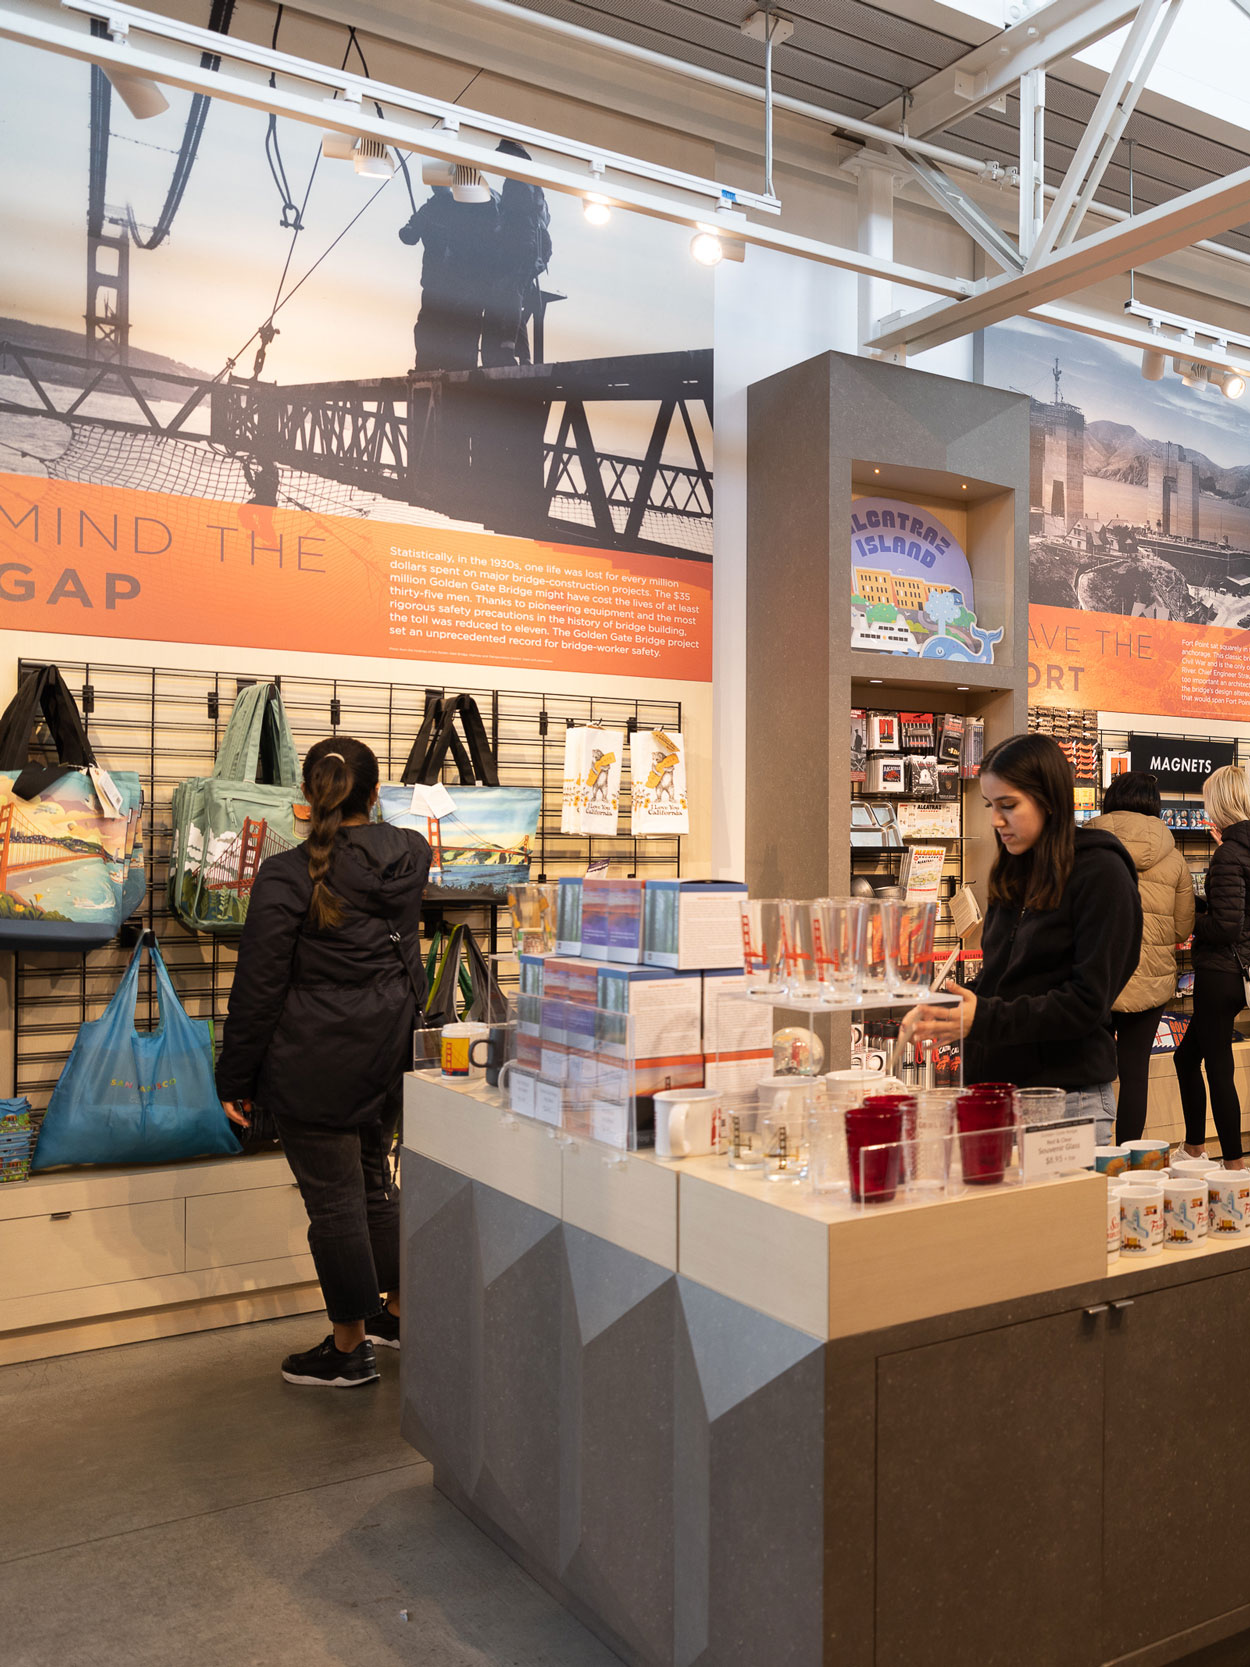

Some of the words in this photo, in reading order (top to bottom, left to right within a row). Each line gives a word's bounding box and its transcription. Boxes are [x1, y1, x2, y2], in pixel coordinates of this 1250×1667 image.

[0, 504, 172, 555] MIND
[206, 525, 326, 573] THE
[851, 510, 951, 556] LCATRAZ
[855, 534, 937, 569] ISLAND
[390, 546, 454, 564] Statistically,
[457, 554, 467, 563] in
[470, 555, 487, 566] the
[490, 558, 521, 571] 1930s,
[524, 564, 543, 572] one
[546, 564, 561, 574] life
[563, 568, 582, 577] was
[585, 568, 602, 579] lost
[605, 571, 618, 581] for
[621, 575, 646, 586] every
[649, 576, 679, 588] million
[390, 559, 426, 571] dollars
[429, 565, 459, 575] spent
[463, 569, 476, 577] on
[479, 570, 508, 582] major
[512, 572, 609, 591] bridge-construction
[611, 584, 650, 596] projects.
[655, 588, 670, 598] The
[673, 590, 691, 600] $35
[0, 562, 141, 610] GAP
[390, 573, 426, 584] million
[429, 576, 468, 589] Golden
[470, 581, 495, 592] Gate
[498, 584, 532, 597] Bridge
[535, 588, 564, 600] might
[566, 591, 589, 602] have
[592, 595, 612, 604] cost
[614, 596, 630, 606] the
[632, 597, 652, 608] lives
[655, 600, 664, 610] of
[667, 602, 675, 611] at
[678, 602, 699, 613] least
[390, 585, 443, 599] thirty-five
[446, 593, 472, 602] men.
[476, 594, 511, 606] Thanks
[514, 598, 525, 607] to
[528, 600, 581, 615] pioneering
[583, 606, 634, 618] equipment
[636, 611, 654, 620] and
[656, 612, 671, 622] the
[673, 615, 696, 625] most
[390, 599, 435, 611] rigorous
[438, 604, 470, 617] safety
[473, 608, 534, 620] precautions
[536, 612, 545, 621] in
[548, 613, 564, 623] the
[567, 615, 600, 628] history
[602, 618, 613, 627] of
[615, 619, 645, 632] bridge
[648, 622, 687, 636] building,
[389, 612, 407, 622] the
[410, 614, 428, 624] toll
[431, 618, 452, 626] was
[455, 619, 498, 630] reduced
[501, 622, 511, 631] to
[514, 623, 548, 635] eleven.
[553, 626, 570, 636] The
[573, 628, 607, 640] Golden
[610, 631, 632, 642] Gate
[634, 633, 665, 646] Bridge
[667, 637, 699, 649] project
[389, 626, 405, 635] set
[409, 629, 422, 637] an
[425, 630, 506, 643] unprecedented
[508, 637, 541, 646] record
[544, 638, 557, 648] for
[561, 639, 628, 654] bridge-worker
[631, 646, 661, 658] safety.
[1096, 629, 1152, 660] THE
[1150, 755, 1212, 773] MAGNETS
[585, 808, 613, 816] California
[110, 1078, 133, 1089] SAN
